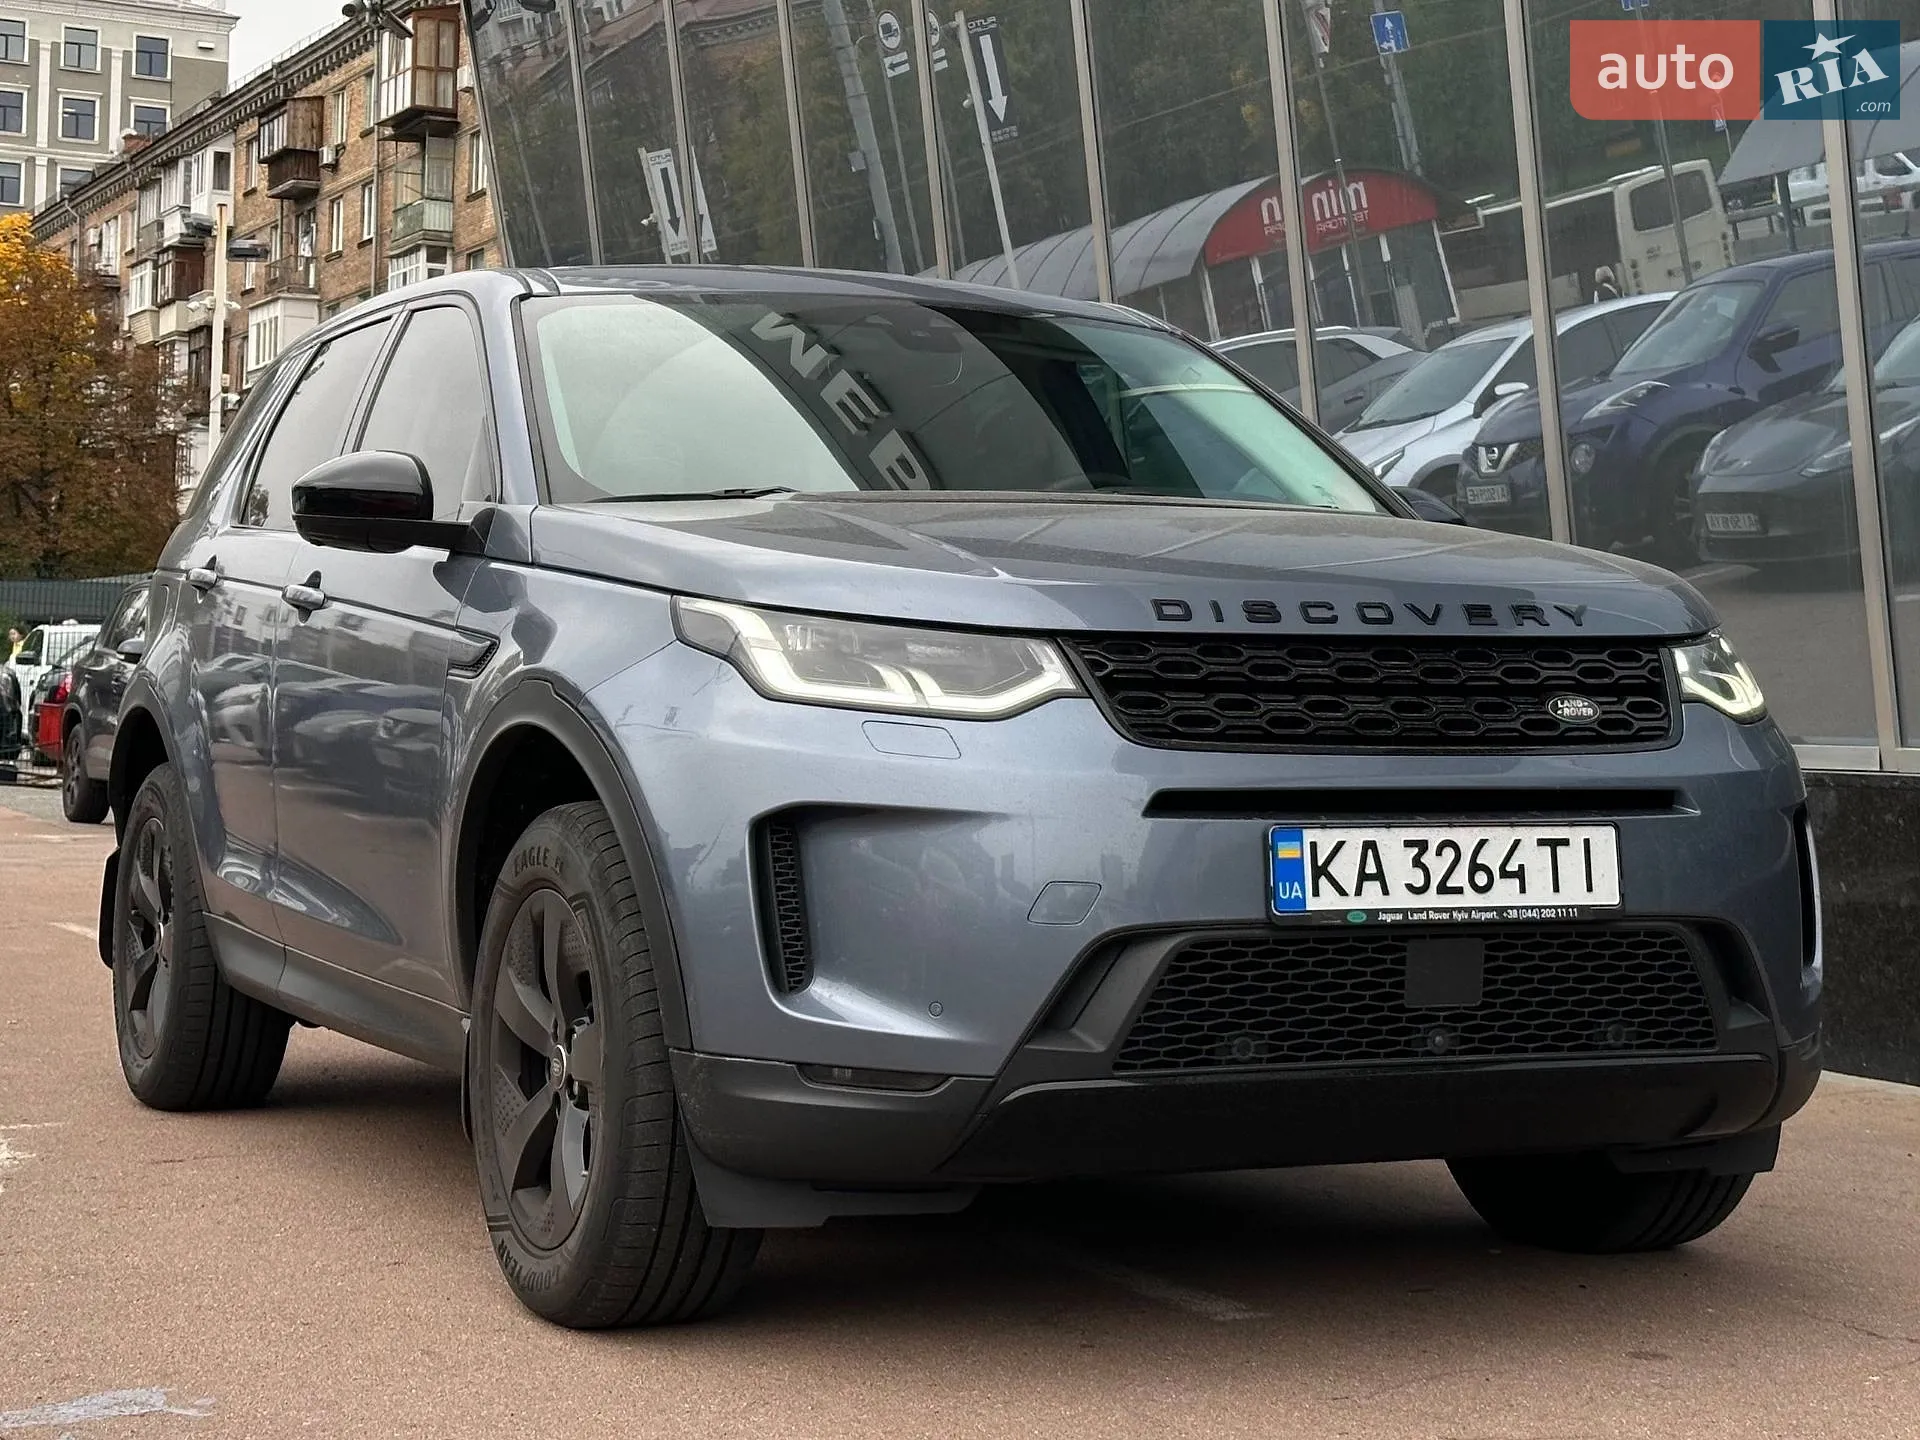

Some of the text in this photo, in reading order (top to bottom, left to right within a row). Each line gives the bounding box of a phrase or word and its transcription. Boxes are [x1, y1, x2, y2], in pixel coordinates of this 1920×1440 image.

[1152, 598, 1588, 627] DISCOVERY
[1557, 699, 1583, 708] LAND
[1563, 707, 1594, 716] ROVER
[513, 846, 551, 878] EAGLE
[1309, 838, 1594, 897] KA 3264 TI
[1279, 881, 1303, 899] UA
[1378, 911, 1403, 922] Jaguar
[1407, 910, 1427, 920] Land
[1428, 910, 1450, 920] Rover
[1452, 909, 1468, 921] Kyiv
[1503, 909, 1518, 919] +38
[1519, 908, 1540, 919] (044)
[1541, 908, 1556, 918] 202
